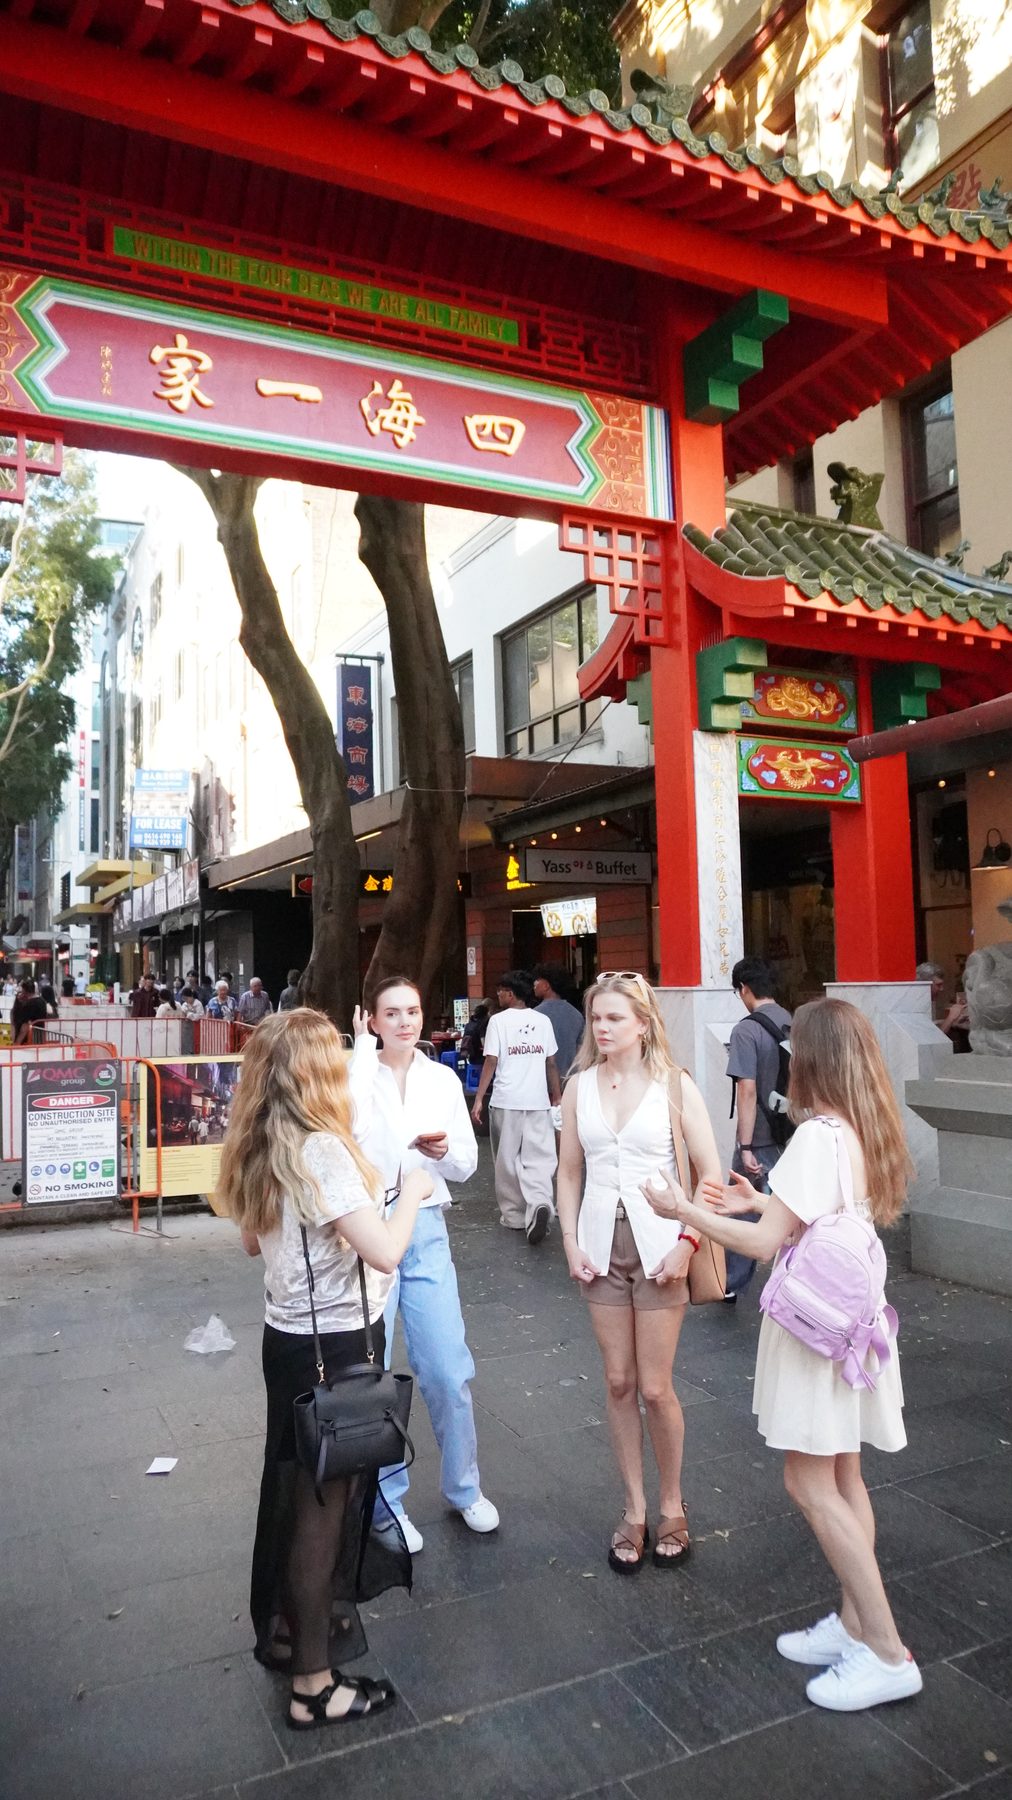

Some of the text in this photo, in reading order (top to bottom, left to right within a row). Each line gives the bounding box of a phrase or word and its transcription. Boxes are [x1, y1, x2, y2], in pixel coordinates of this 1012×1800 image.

[133, 235, 505, 339] WITHIN THE FOUR SEAS WE ARE ALL FAMILY
[135, 818, 182, 830] FOR LEASE
[542, 860, 572, 874] Yass
[596, 861, 637, 876] Buffet
[60, 1079, 86, 1087] group
[49, 1096, 94, 1107] DANGER
[28, 1108, 115, 1121] CONSTRUCTION SITE
[40, 1118, 93, 1127] UNAUTHORISED
[45, 1181, 114, 1192] NO SMOKING
